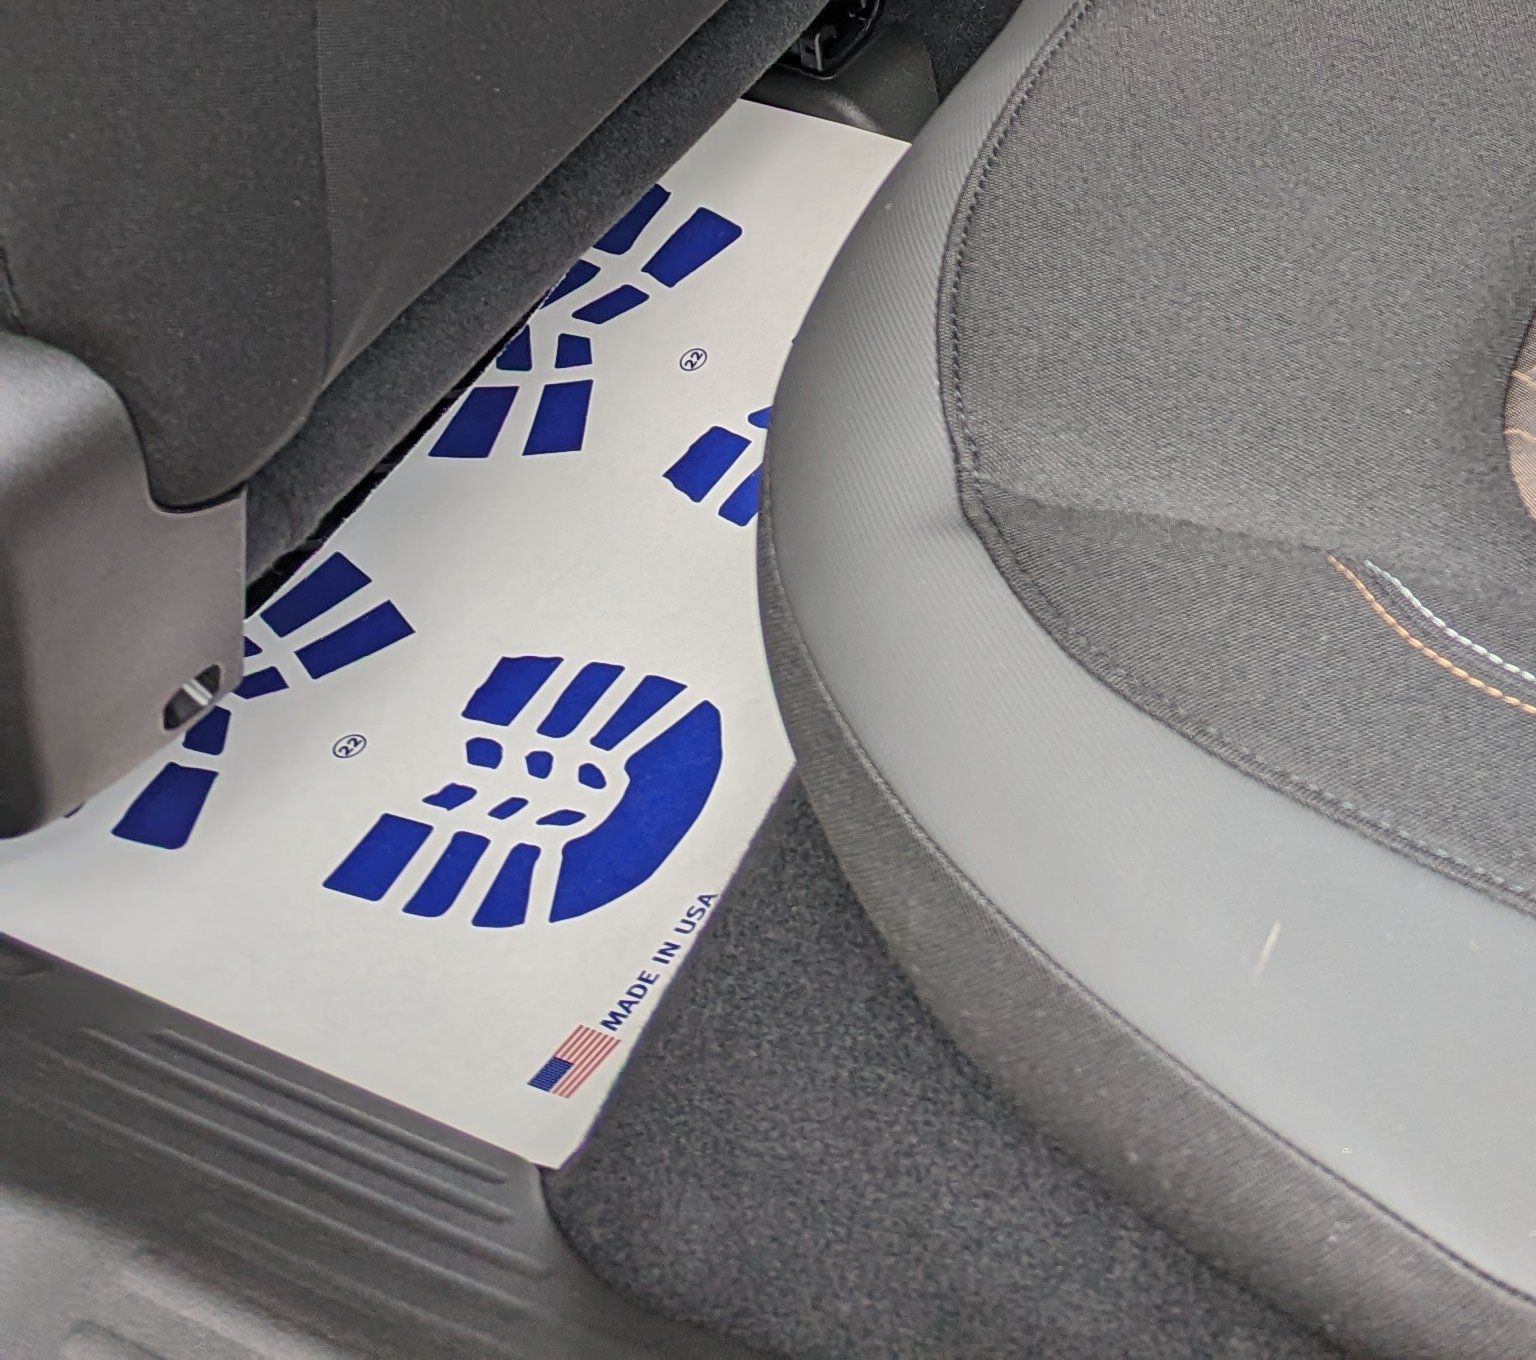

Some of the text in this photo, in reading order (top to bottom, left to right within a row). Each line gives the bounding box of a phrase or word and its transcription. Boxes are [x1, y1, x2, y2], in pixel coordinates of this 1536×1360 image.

[684, 351, 704, 369] 22
[337, 737, 363, 756] 22
[600, 893, 719, 1032] MADE IN USA
